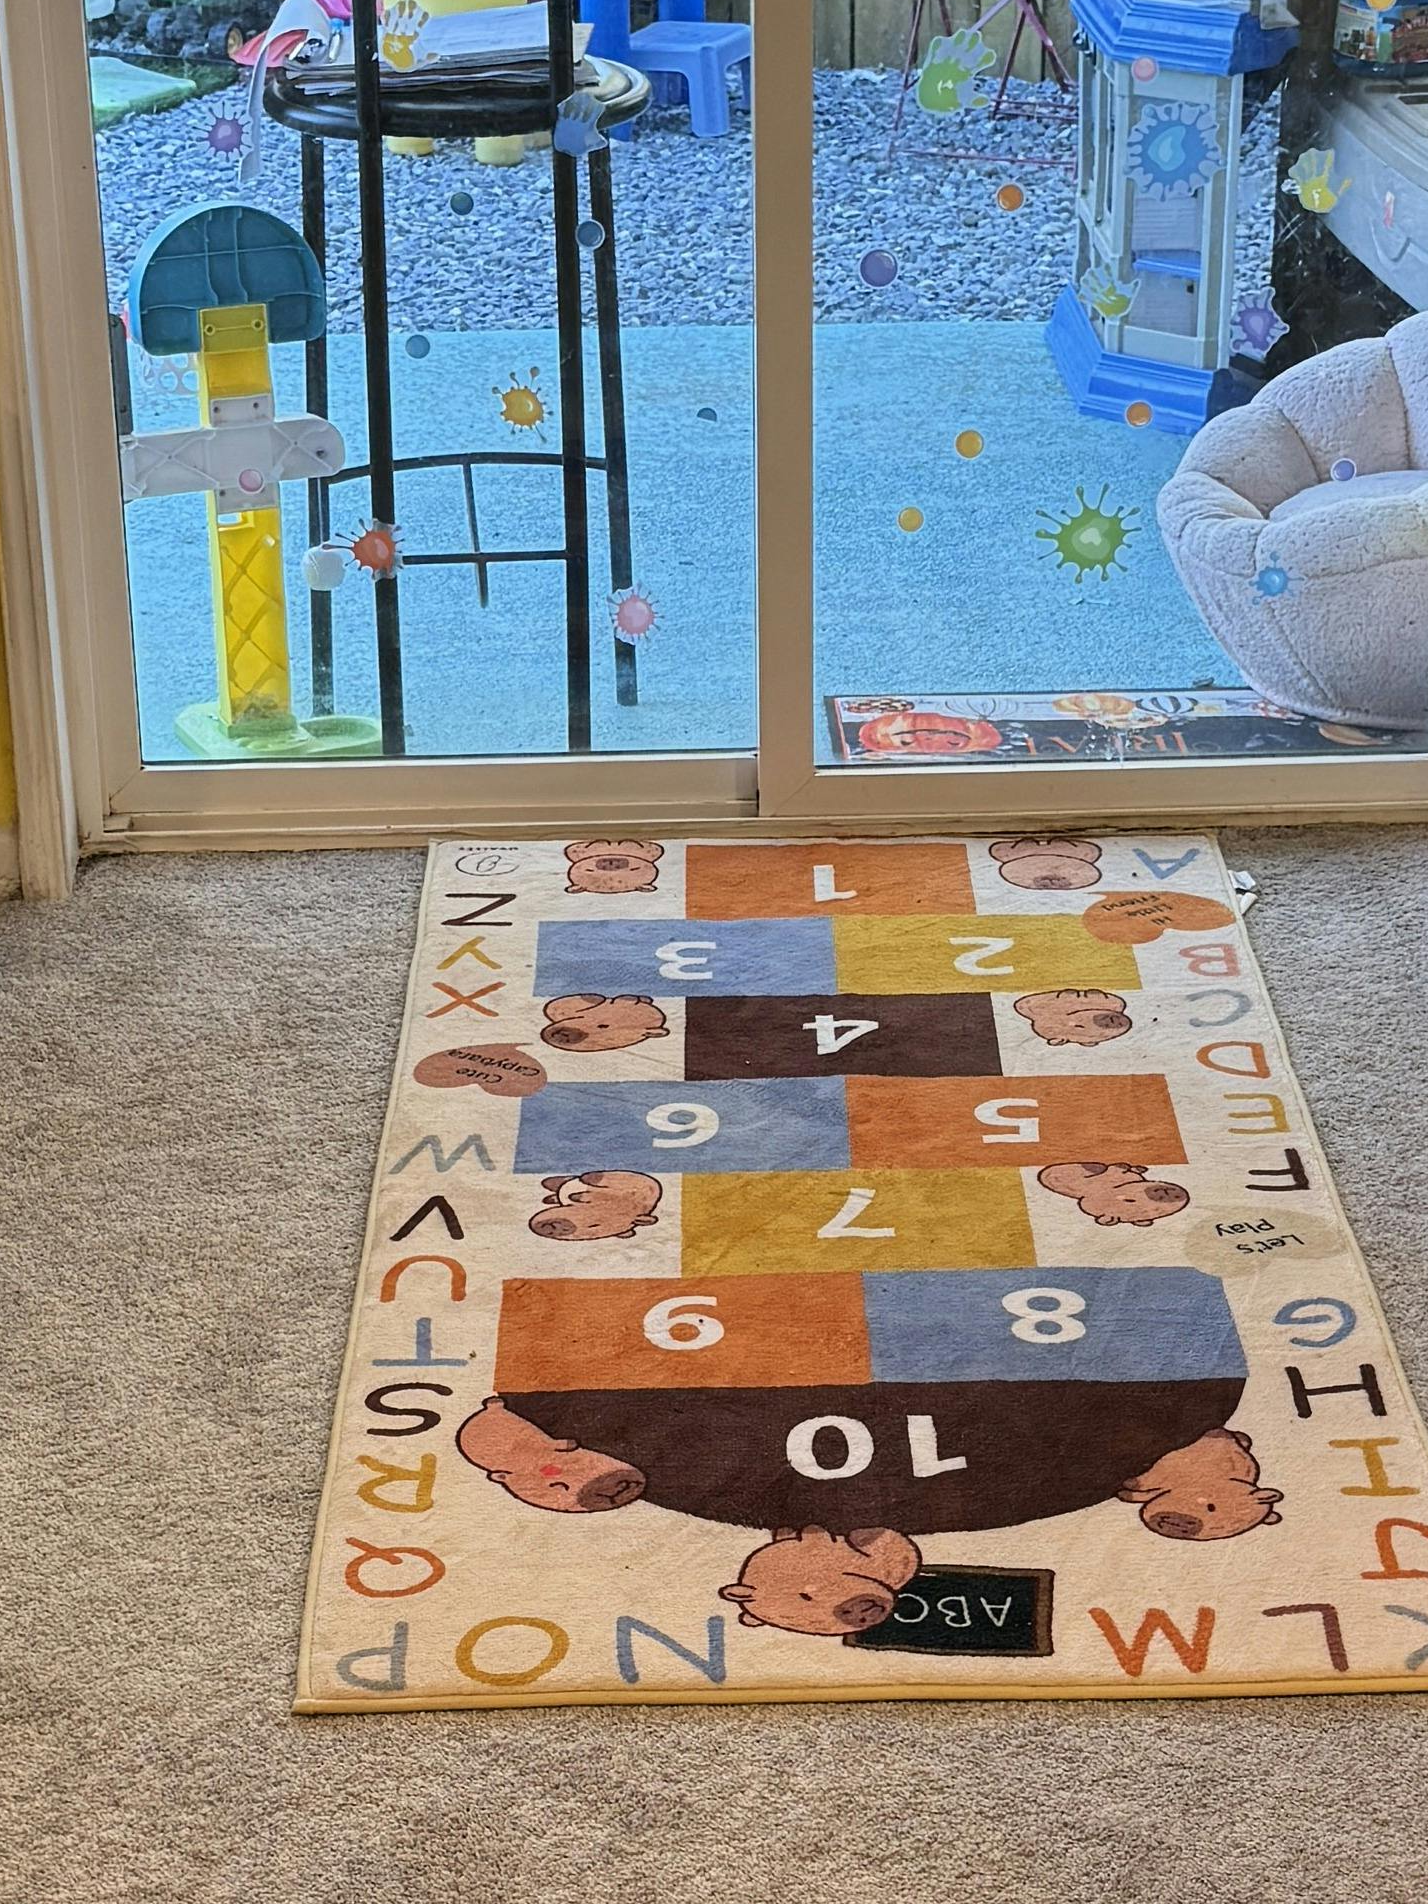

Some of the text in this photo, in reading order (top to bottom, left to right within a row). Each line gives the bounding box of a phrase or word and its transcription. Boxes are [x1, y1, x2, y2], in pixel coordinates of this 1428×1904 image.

[812, 864, 858, 902] 1
[1132, 847, 1201, 880] A
[441, 893, 517, 926] Z
[436, 936, 503, 970] Y
[655, 941, 717, 981] 3
[949, 936, 1015, 976] 2
[1178, 942, 1242, 978] B
[424, 981, 507, 1019] X
[1187, 989, 1253, 1029] C
[801, 1014, 879, 1056] 4
[445, 1047, 541, 1078] Capybara
[455, 1066, 503, 1085] Cute
[1195, 1041, 1272, 1080] D
[645, 1102, 720, 1149] 6
[973, 1097, 1040, 1144] 5
[1223, 1093, 1293, 1135] E
[387, 1133, 497, 1175] W
[1245, 1147, 1311, 1192] F
[388, 1195, 467, 1242] V
[817, 1187, 897, 1239] 7
[1236, 1233, 1306, 1255] Let's
[379, 1255, 468, 1304] U
[643, 1296, 725, 1351] 9
[1001, 1286, 1086, 1345] 8
[1272, 1297, 1357, 1348] G
[373, 1317, 469, 1368] T
[364, 1382, 454, 1438] S
[1284, 1363, 1388, 1419] H
[785, 1414, 969, 1481] 10
[356, 1452, 438, 1515] R
[344, 1535, 447, 1599] Q
[891, 1592, 1014, 1629] ABC
[335, 1620, 410, 1692] P
[454, 1615, 571, 1687] O
[615, 1614, 729, 1686] N
[1088, 1605, 1217, 1679] M
[1263, 1602, 1350, 1673] L
